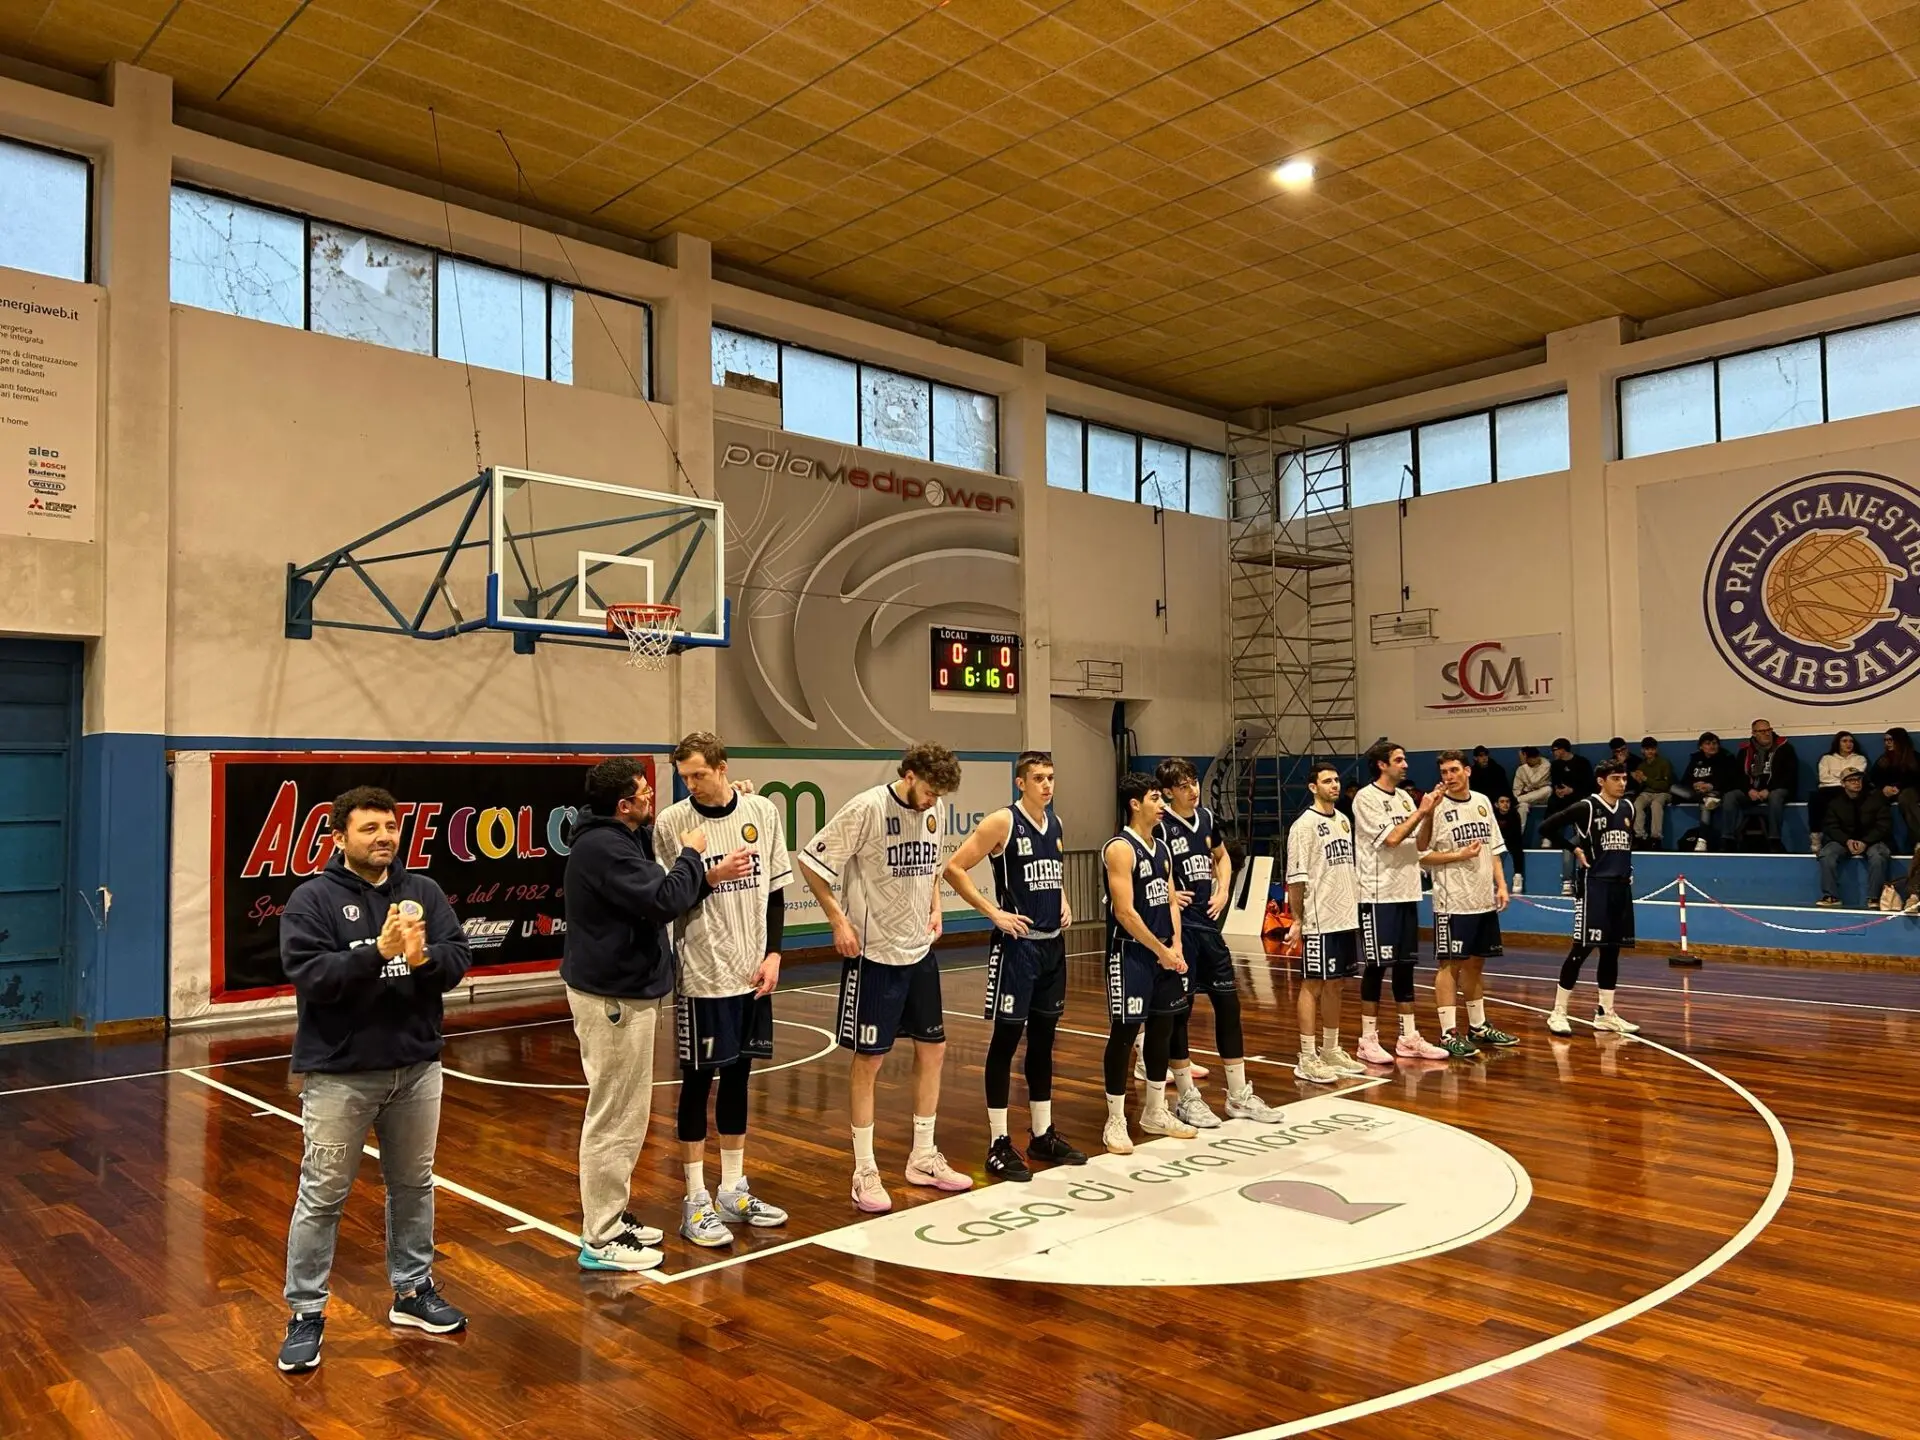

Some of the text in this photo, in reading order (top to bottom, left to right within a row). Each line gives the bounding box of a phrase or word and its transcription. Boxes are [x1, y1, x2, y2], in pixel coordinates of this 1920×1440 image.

[7, 417, 29, 427] home
[40, 461, 66, 470] BOSCH
[940, 630, 1015, 644] LOCALI OSPITI
[952, 643, 963, 664] 0
[1001, 646, 1011, 667] 0
[940, 668, 948, 686] 0
[1006, 672, 1015, 689] 0
[944, 803, 985, 835] lus
[1444, 809, 1460, 822] 67
[1594, 816, 1607, 830] 73
[240, 780, 579, 879] AGTE COLO
[886, 816, 900, 836] 10
[1317, 822, 1331, 837] 35
[887, 841, 937, 867] DIERRE
[1016, 837, 1033, 856] 12
[1171, 837, 1190, 856] 22
[892, 865, 933, 878] BASKETBALL
[1139, 859, 1153, 879] 20
[466, 883, 501, 904] dal
[504, 884, 550, 901] 1982
[712, 878, 760, 895] SKETBALL
[1573, 897, 1583, 940] DIERRE
[1362, 912, 1376, 960] DIERRE
[1588, 928, 1602, 941] 73
[1380, 945, 1393, 959] 55
[1451, 941, 1464, 953] 67
[1109, 952, 1122, 1015] DIERRE
[1000, 993, 1015, 1014] 12
[1127, 996, 1144, 1015] 20
[678, 997, 690, 1060] DIERR
[860, 1025, 878, 1044] 10
[702, 1036, 715, 1059] 7
[914, 1112, 1375, 1246] Casa di cura morana
